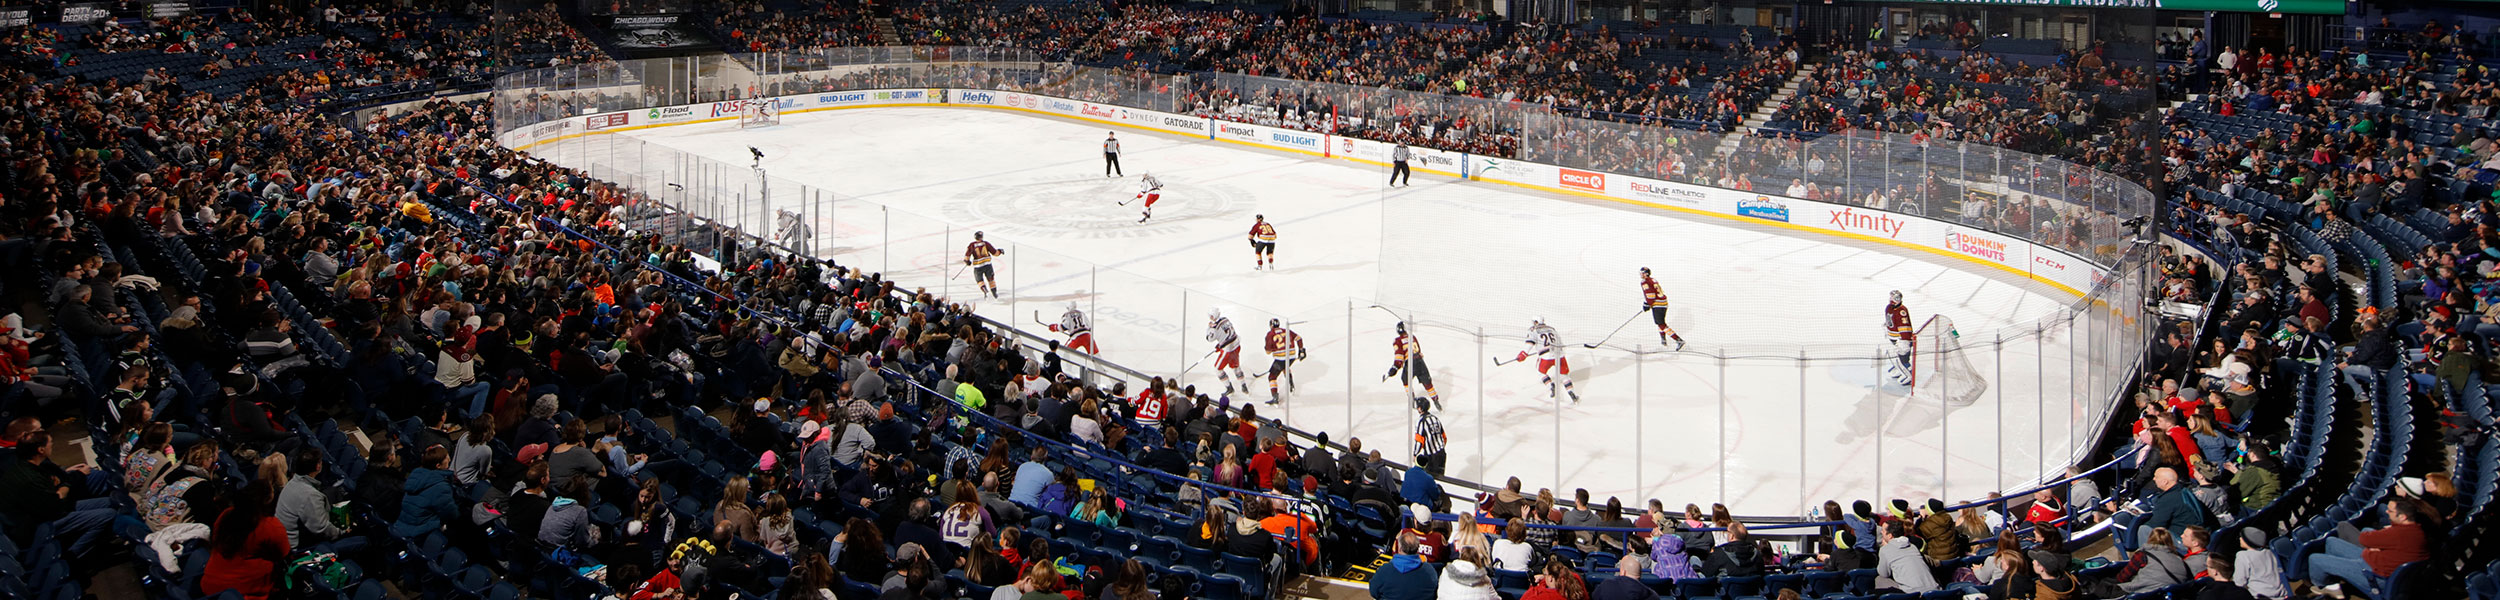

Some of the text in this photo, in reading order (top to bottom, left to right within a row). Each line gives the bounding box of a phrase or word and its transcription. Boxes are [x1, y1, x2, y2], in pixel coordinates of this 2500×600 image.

[7, 10, 28, 18] YOUR
[64, 7, 91, 15] PARTY
[92, 9, 110, 18] 20+
[8, 18, 29, 26] HERE
[62, 14, 90, 22] DECKS
[820, 94, 865, 103] BUD LIGHT
[962, 92, 993, 104] Hefty
[1053, 101, 1074, 112] Allstate
[1081, 103, 1115, 118] Butternut
[1130, 112, 1159, 123] DYNEGY
[1164, 117, 1204, 131] GATORADE
[1226, 125, 1254, 137] impact
[1273, 133, 1290, 142] BUD
[1291, 135, 1316, 147] LIGHT
[1428, 155, 1453, 166] STRONG
[1562, 174, 1589, 185] CIRCLE
[1671, 190, 1705, 199] ATHLETICS
[1740, 199, 1780, 210] Campfire
[1830, 208, 1904, 238] xfinity
[1962, 234, 2007, 251] DUNKIN'
[974, 245, 989, 257] 14
[1962, 243, 2005, 262] DONUTS
[2036, 256, 2065, 271] CCM
[1540, 332, 1556, 347] 26
[1139, 397, 1161, 418] 19
[946, 513, 970, 537] 12
